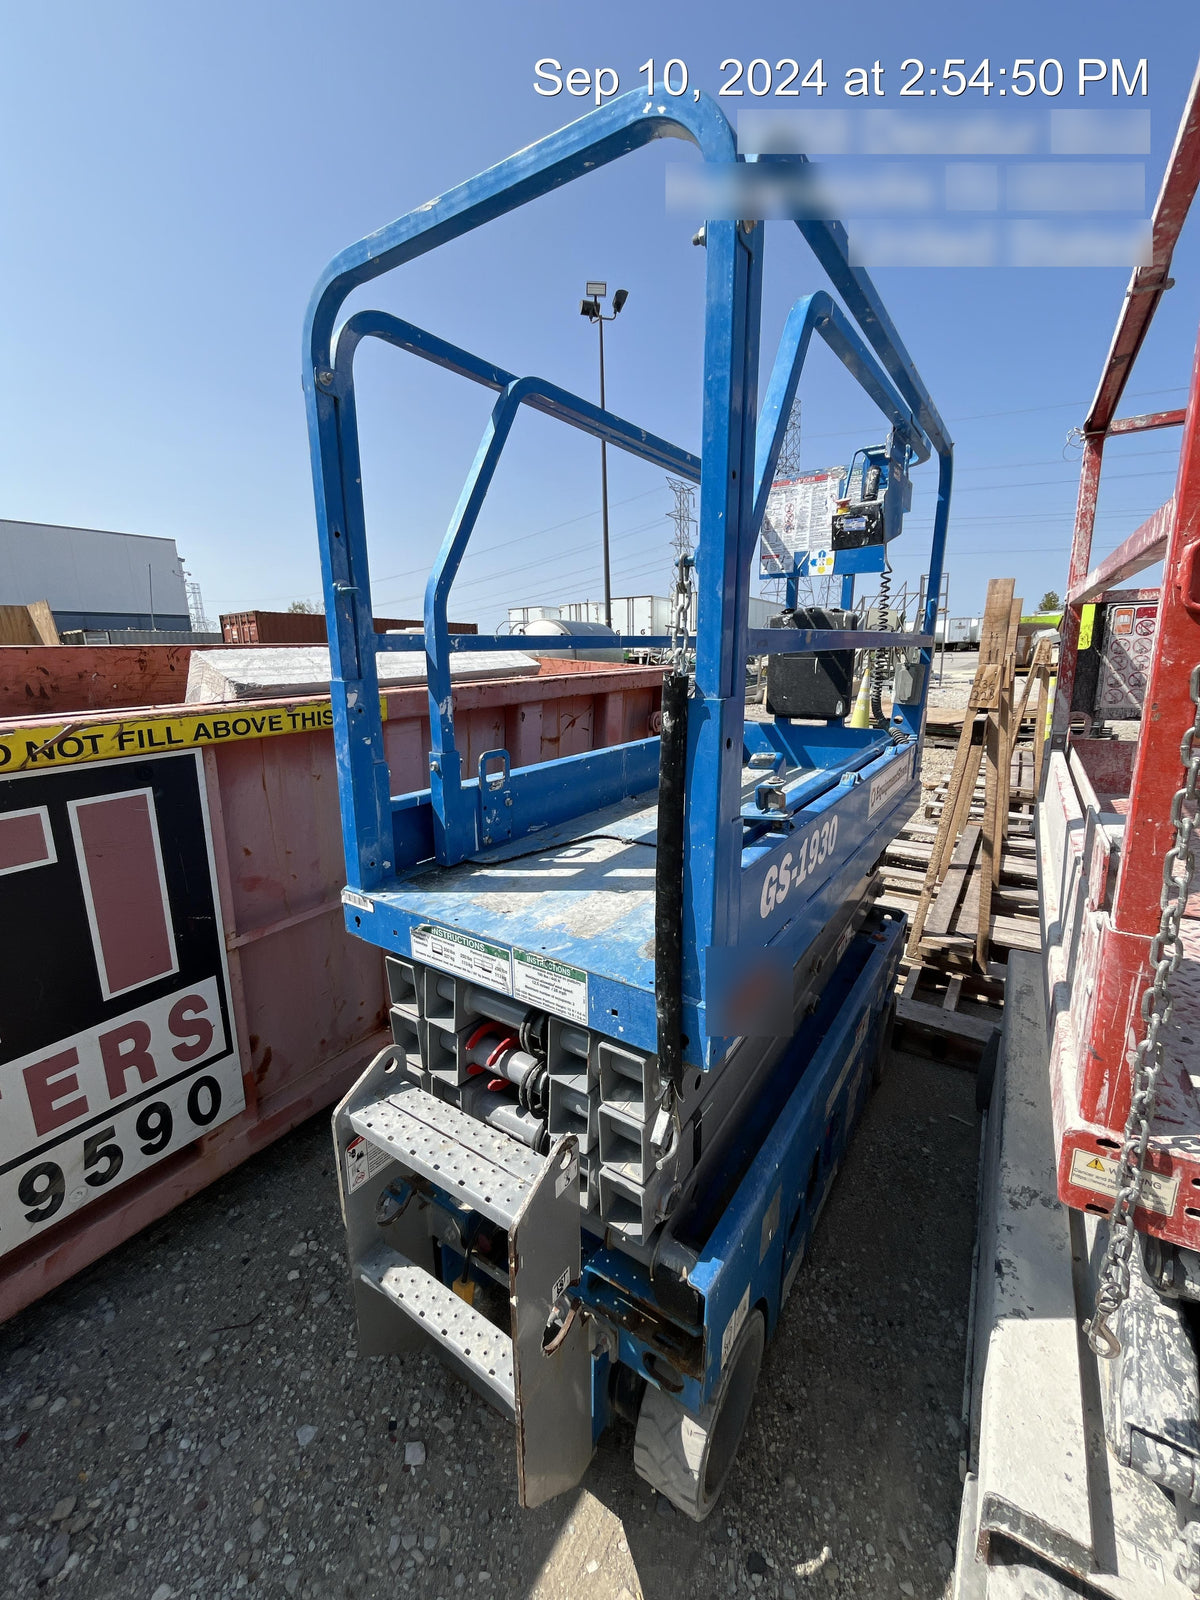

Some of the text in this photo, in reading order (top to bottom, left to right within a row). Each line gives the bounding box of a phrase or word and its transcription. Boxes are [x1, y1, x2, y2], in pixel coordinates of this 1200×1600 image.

[25, 733, 104, 763] NOT
[118, 726, 185, 751] FILL
[193, 714, 284, 742] ABOVE
[287, 709, 334, 730] THIS
[760, 814, 839, 919] GS-1930
[431, 928, 485, 952] INSTRUCTIONS
[22, 994, 214, 1138] ERS
[17, 1075, 222, 1223] 9590
